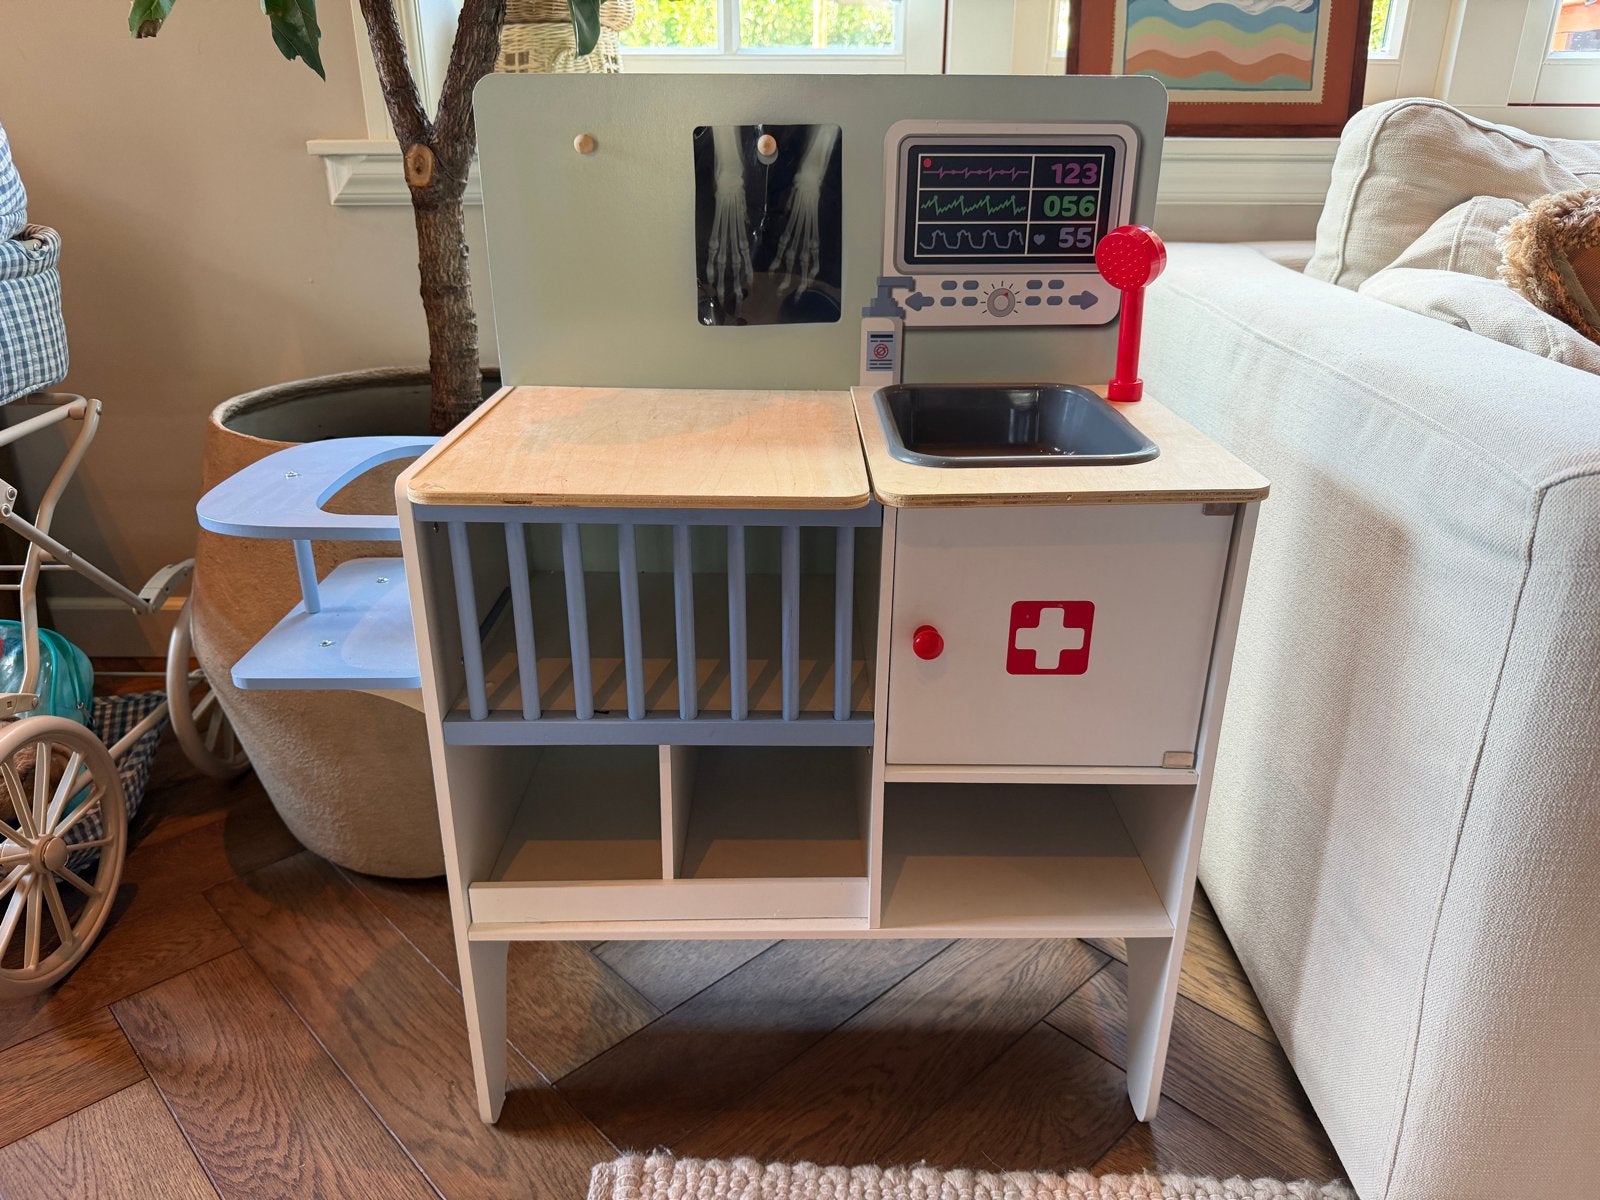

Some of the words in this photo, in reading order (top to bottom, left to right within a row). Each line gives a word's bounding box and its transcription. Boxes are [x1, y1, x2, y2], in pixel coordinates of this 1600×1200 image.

[1051, 162, 1097, 184] 123
[1043, 195, 1095, 217] 056
[1058, 227, 1092, 248] 55
